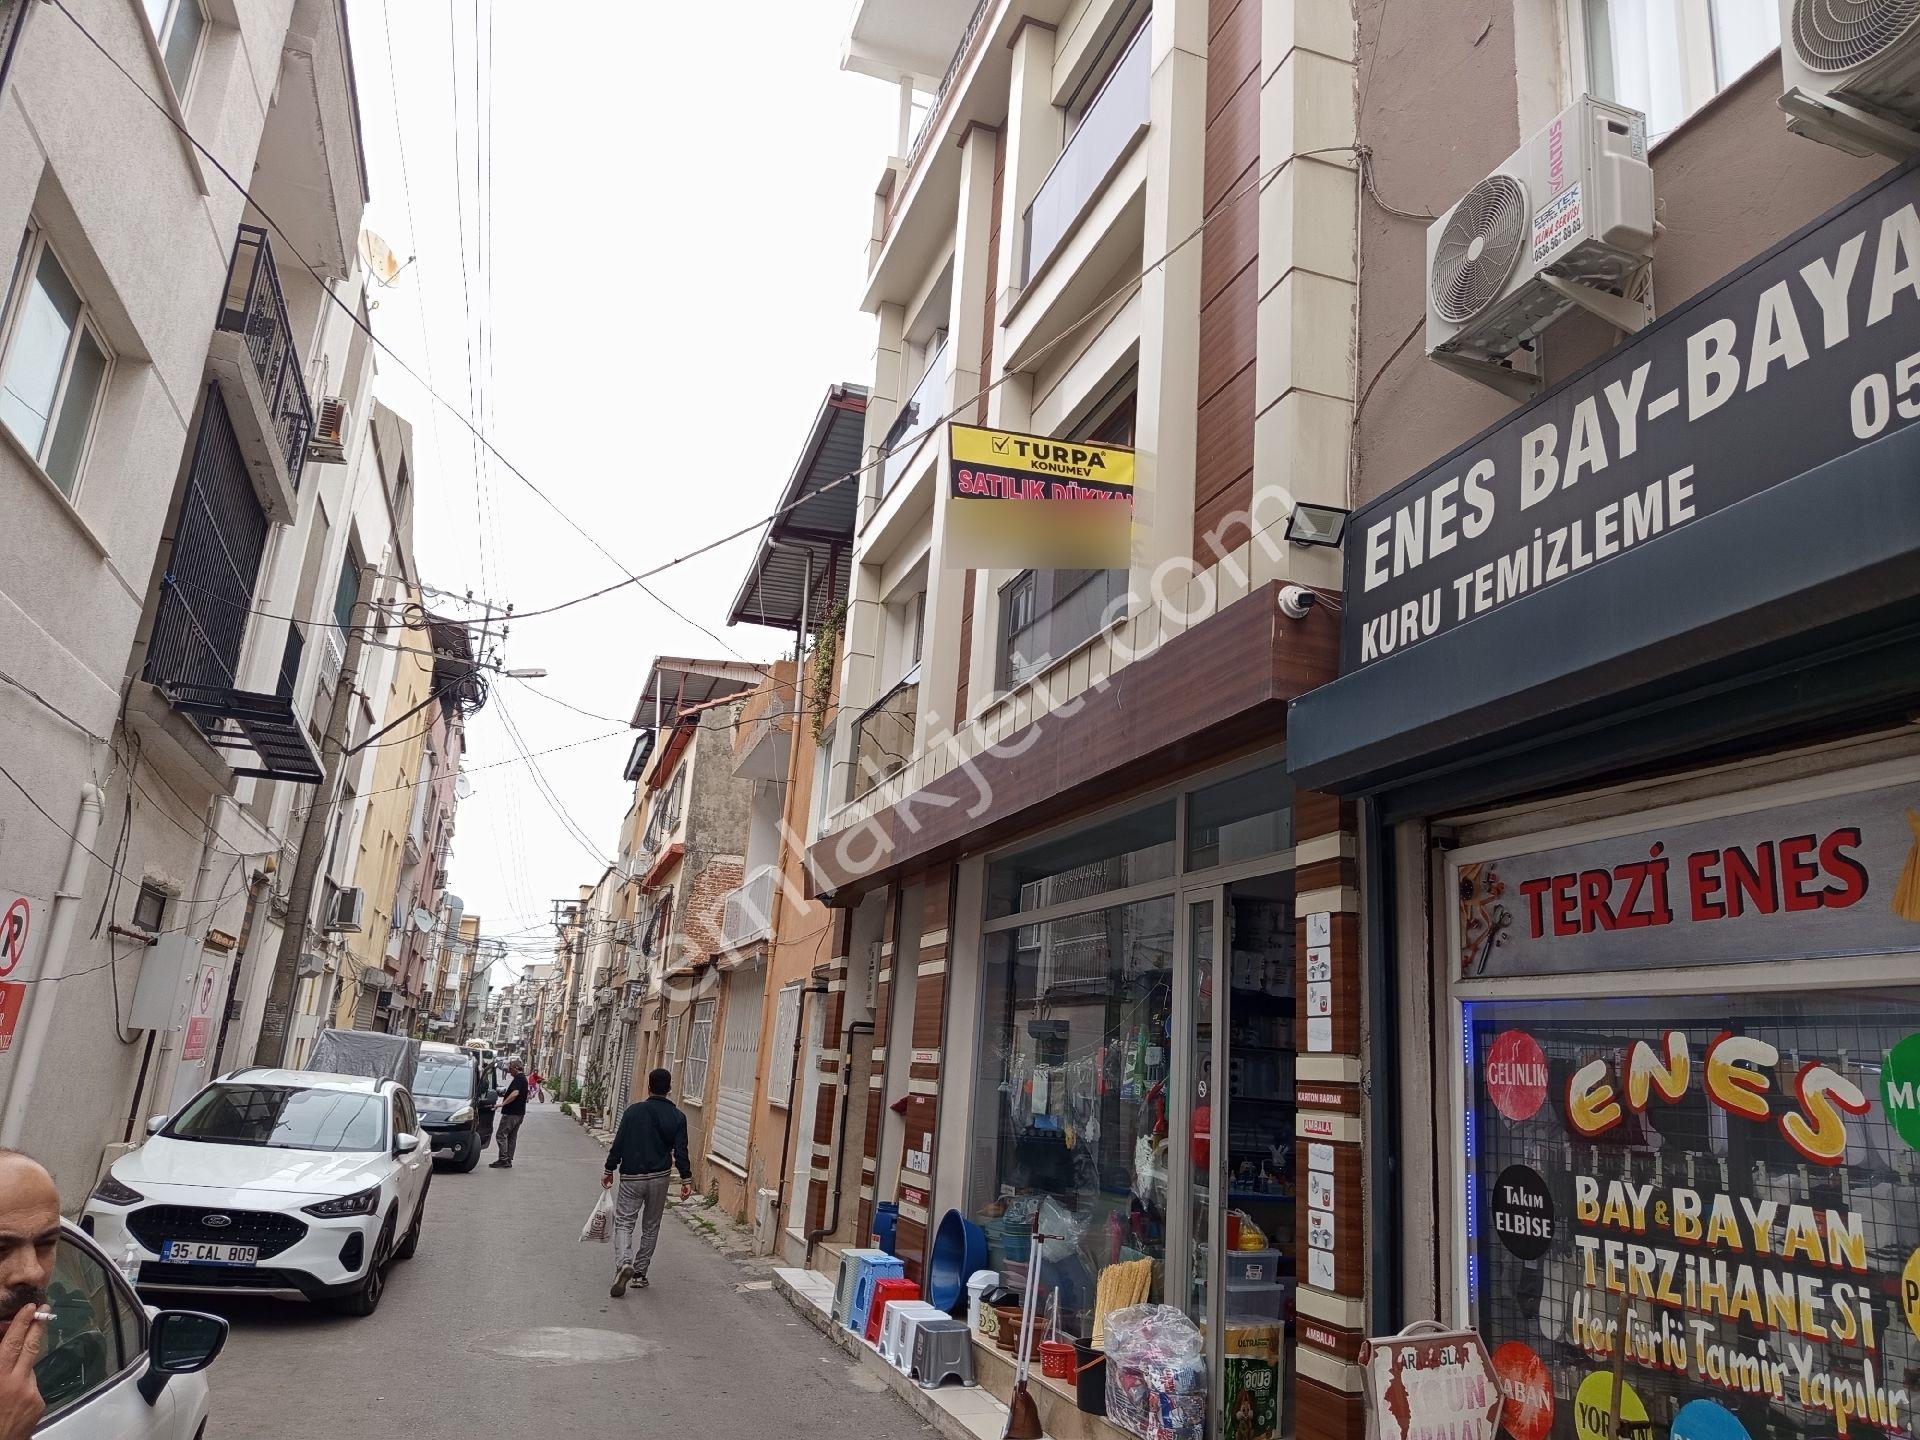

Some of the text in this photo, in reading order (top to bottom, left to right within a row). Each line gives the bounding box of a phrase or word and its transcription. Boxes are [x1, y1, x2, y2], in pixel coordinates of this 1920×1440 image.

[1534, 240, 1550, 263] 0536
[1013, 439, 1106, 470] TURPA
[1030, 459, 1092, 478] KONUMEV
[958, 469, 1046, 500] SATILIK
[1363, 459, 1496, 593] ENES
[1361, 464, 1697, 663] KURU TEMİZLEME
[1519, 827, 1869, 940] TERZİ ENES
[1297, 1091, 1342, 1105] KARTON BARDAK
[1565, 1030, 1872, 1166] ENES
[1575, 1175, 1868, 1274] BAY & BAYAN
[171, 1243, 189, 1259] 35
[196, 1245, 222, 1261] CAL
[229, 1247, 255, 1262] 809
[1305, 1327, 1336, 1348] AMBALAJ
[1573, 1290, 1618, 1356] Her
[1689, 1318, 1789, 1400] Tamir
[1502, 1378, 1552, 1413] ABAN
